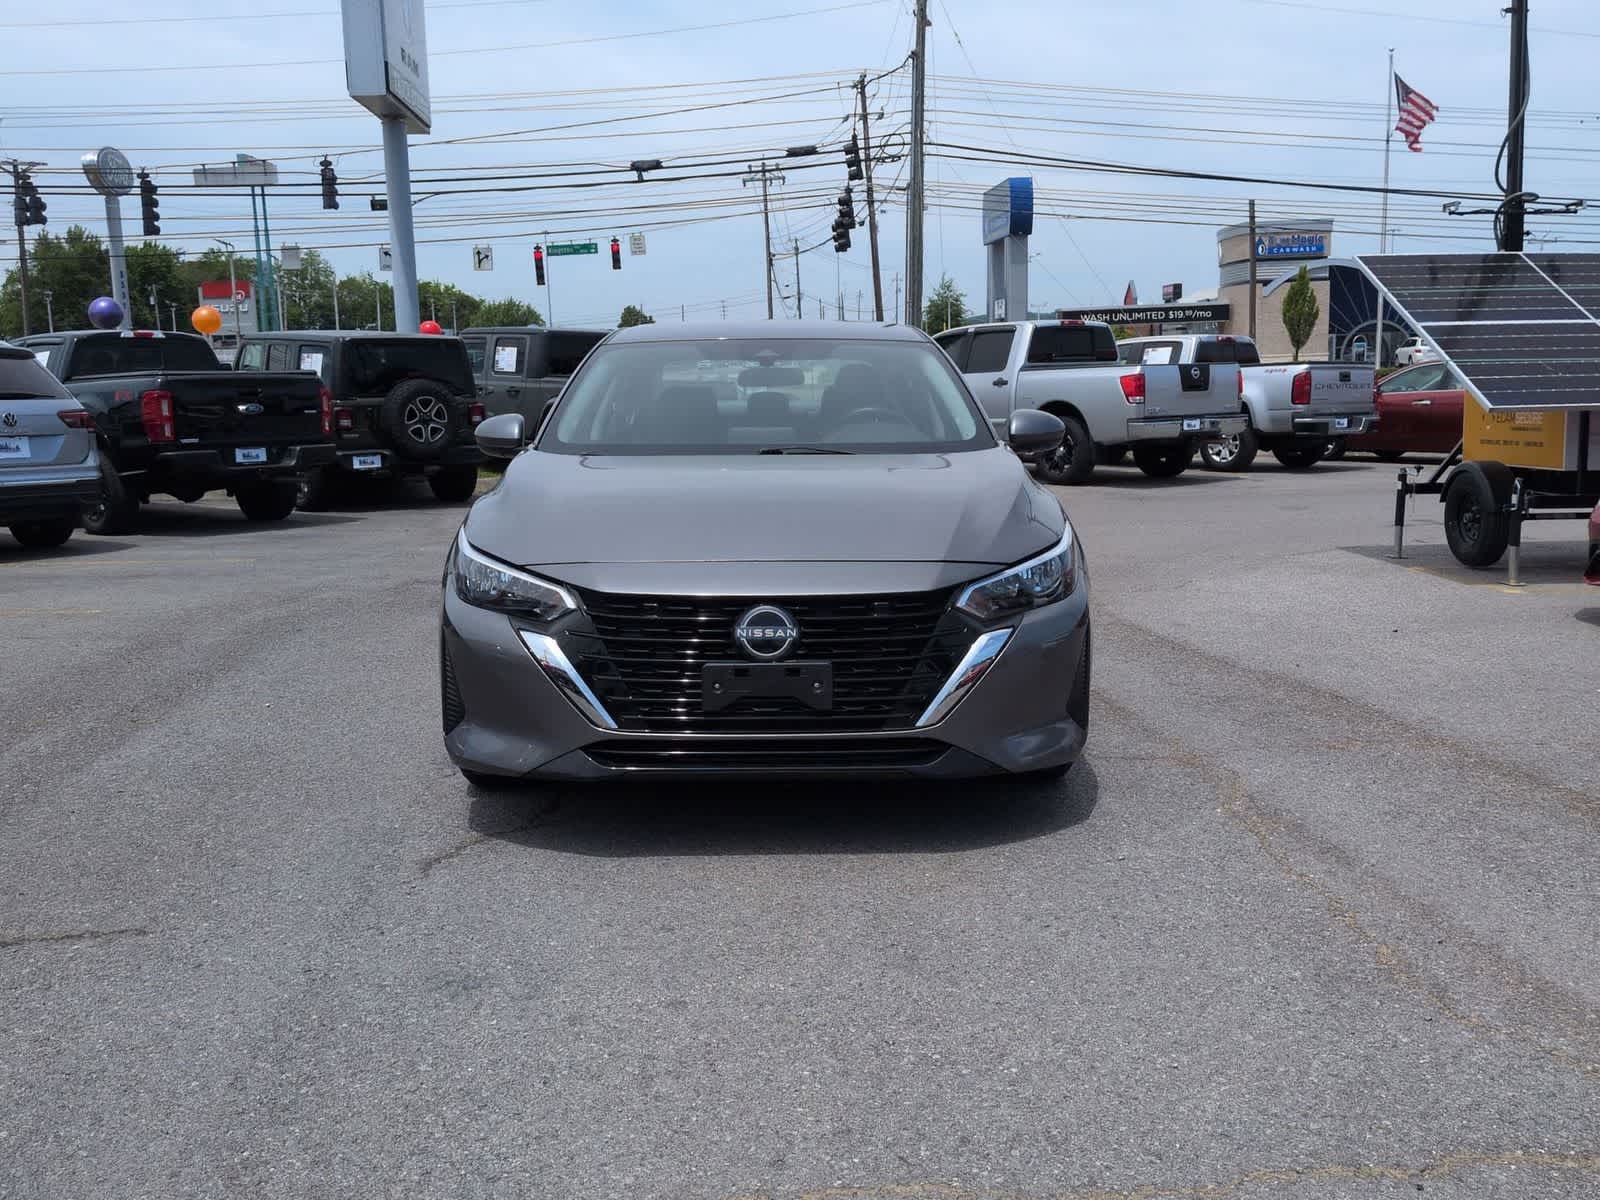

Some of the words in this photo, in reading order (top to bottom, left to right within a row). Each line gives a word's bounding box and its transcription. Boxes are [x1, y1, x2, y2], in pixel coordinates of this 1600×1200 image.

[1080, 312, 1110, 321] WASH
[1112, 310, 1165, 321] UNLIMITED
[1314, 382, 1371, 391] CHEVROLET
[737, 628, 796, 637] NISSAN
